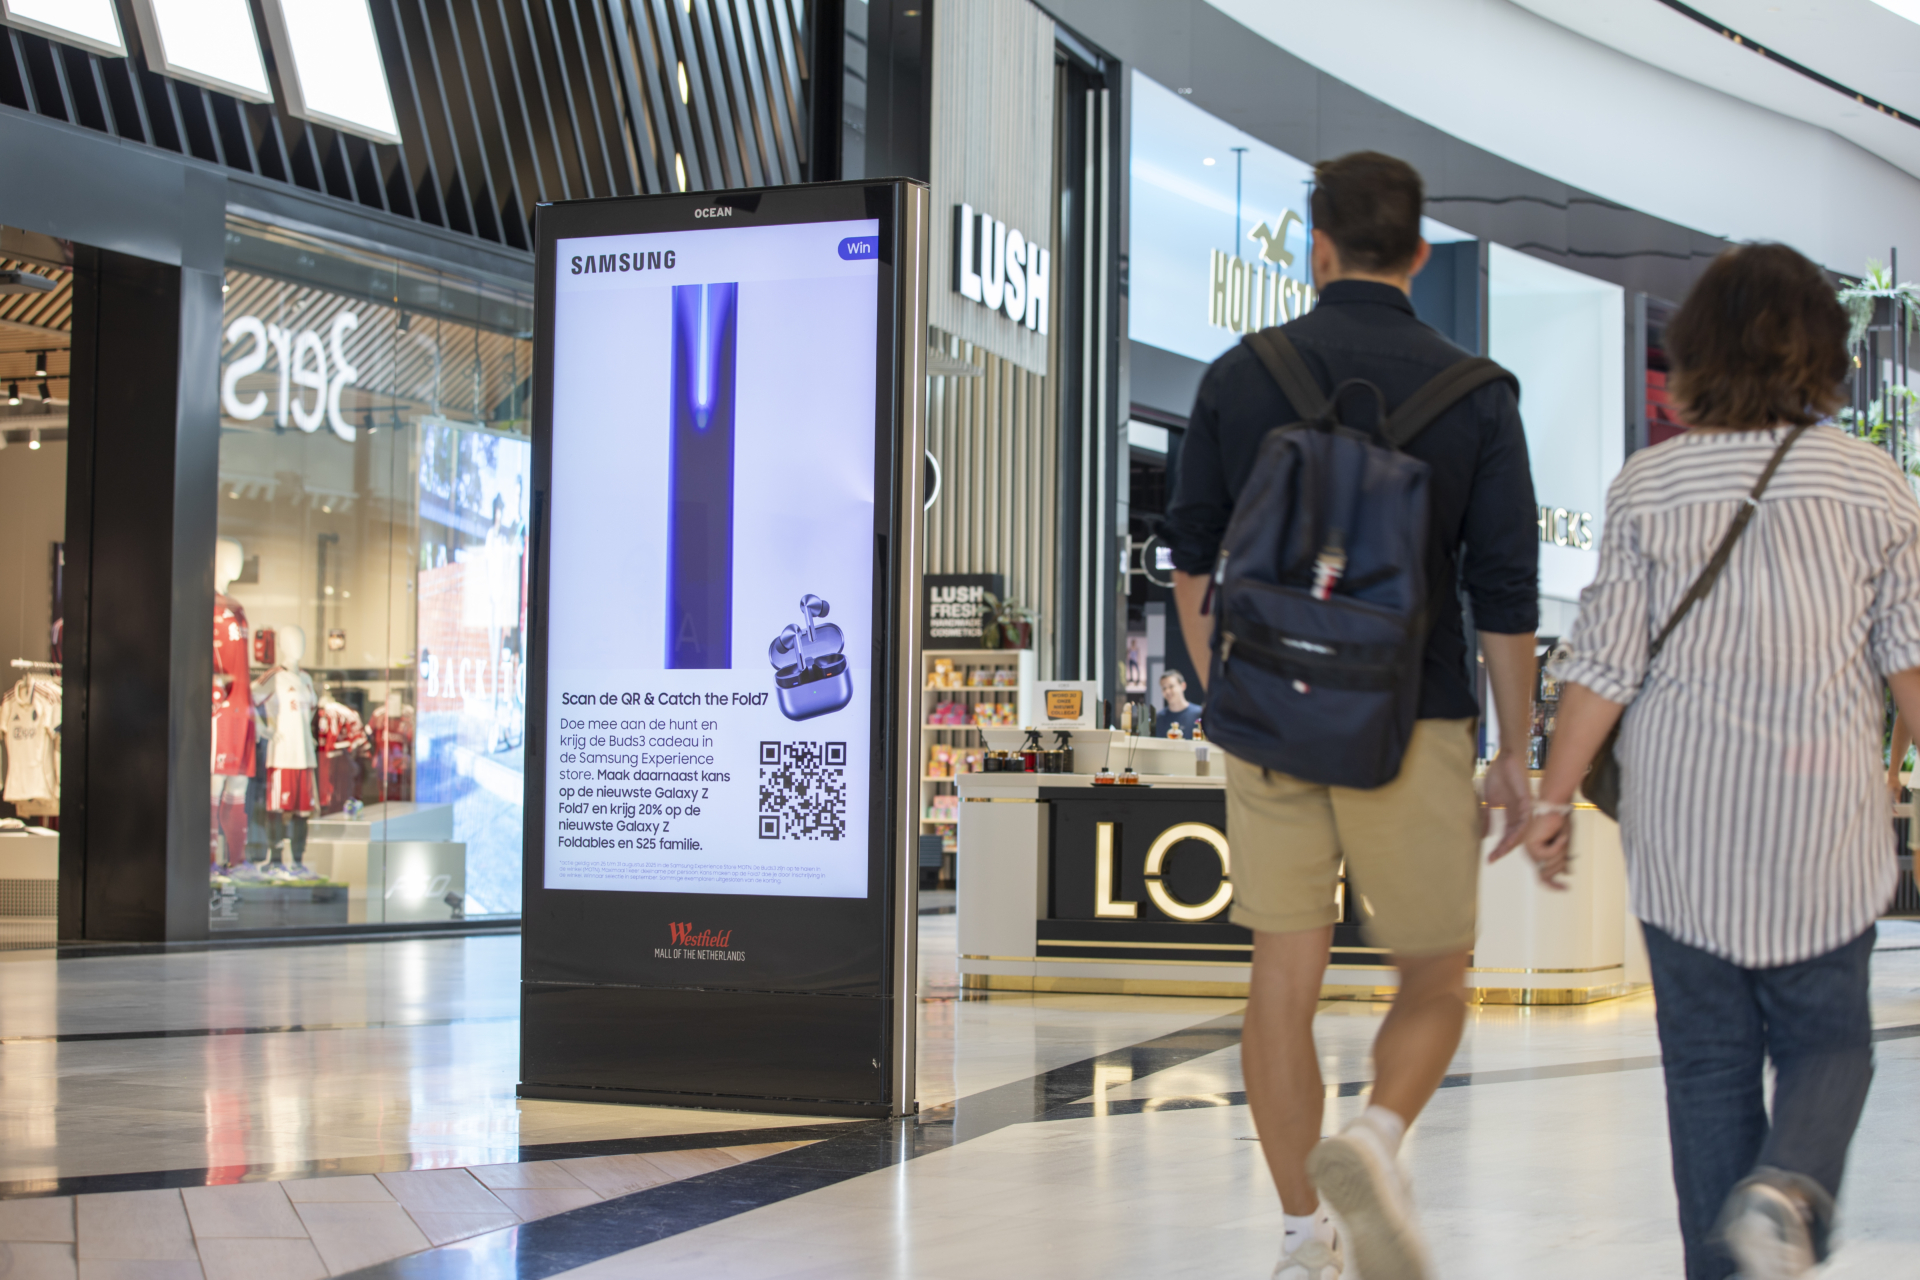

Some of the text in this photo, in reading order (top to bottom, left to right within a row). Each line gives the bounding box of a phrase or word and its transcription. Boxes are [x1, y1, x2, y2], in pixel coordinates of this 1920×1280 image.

[694, 207, 732, 218] OCEAN
[847, 242, 871, 255] Win
[571, 250, 676, 275] SAMSUNG
[957, 203, 1050, 336] LUSH
[930, 586, 984, 603] LUSH
[930, 604, 984, 617] FRESH
[930, 628, 983, 637] COSMETICS
[426, 654, 487, 700] BACK
[561, 692, 768, 705] Scan de QR & Catch the Fold7
[560, 718, 717, 730] Doe mee aan de hunt en
[560, 734, 712, 750] krijg de Buds3 cadeau in
[559, 751, 714, 767] de Samsung Experience
[559, 769, 730, 782] store. Maak daarnaast kans
[559, 785, 708, 801] op de nieuwste Galaxy Z
[558, 802, 700, 819] Fold7 en krijg 20% op de
[558, 818, 669, 835] nieuwste Galaxy Z
[558, 836, 702, 850] Foldables en S25 familie.
[668, 922, 733, 948] Westfield
[655, 948, 746, 962] MALL OF THE NETHERLANDS
